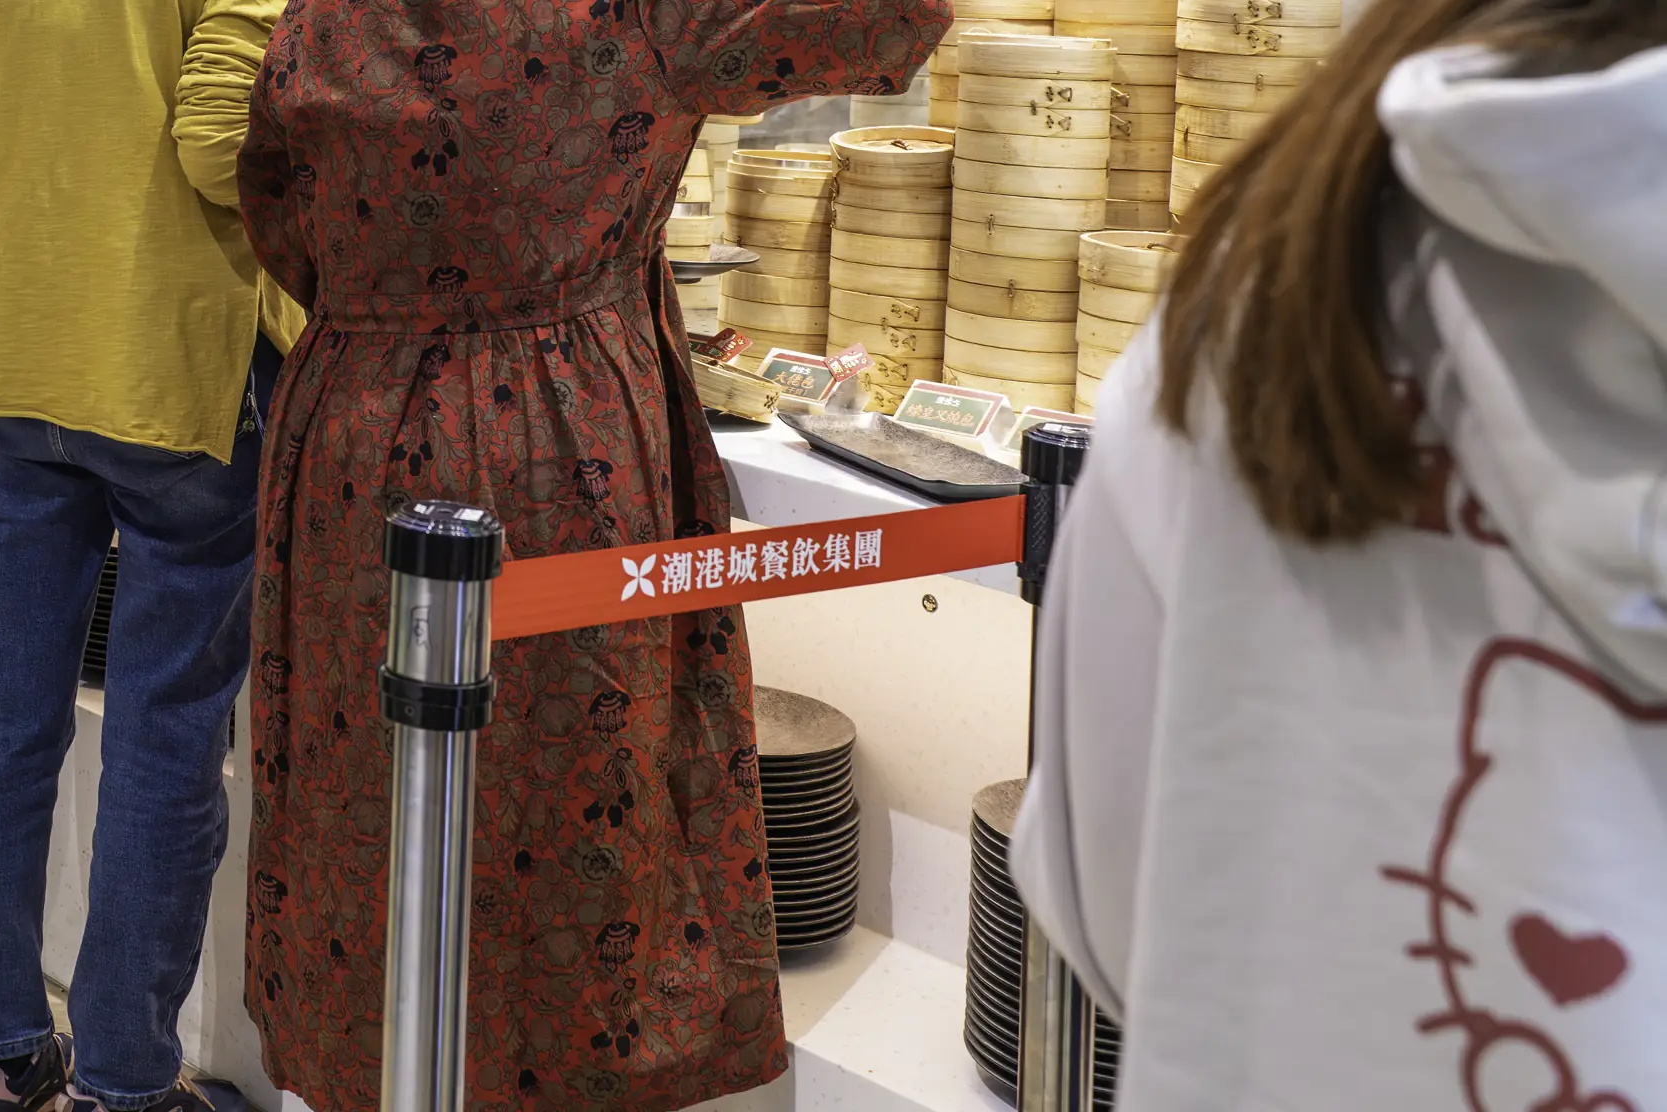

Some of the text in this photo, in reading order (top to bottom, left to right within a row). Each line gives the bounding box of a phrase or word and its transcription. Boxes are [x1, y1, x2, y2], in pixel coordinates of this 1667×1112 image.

[661, 528, 884, 595] 潮港城餐飲集團
